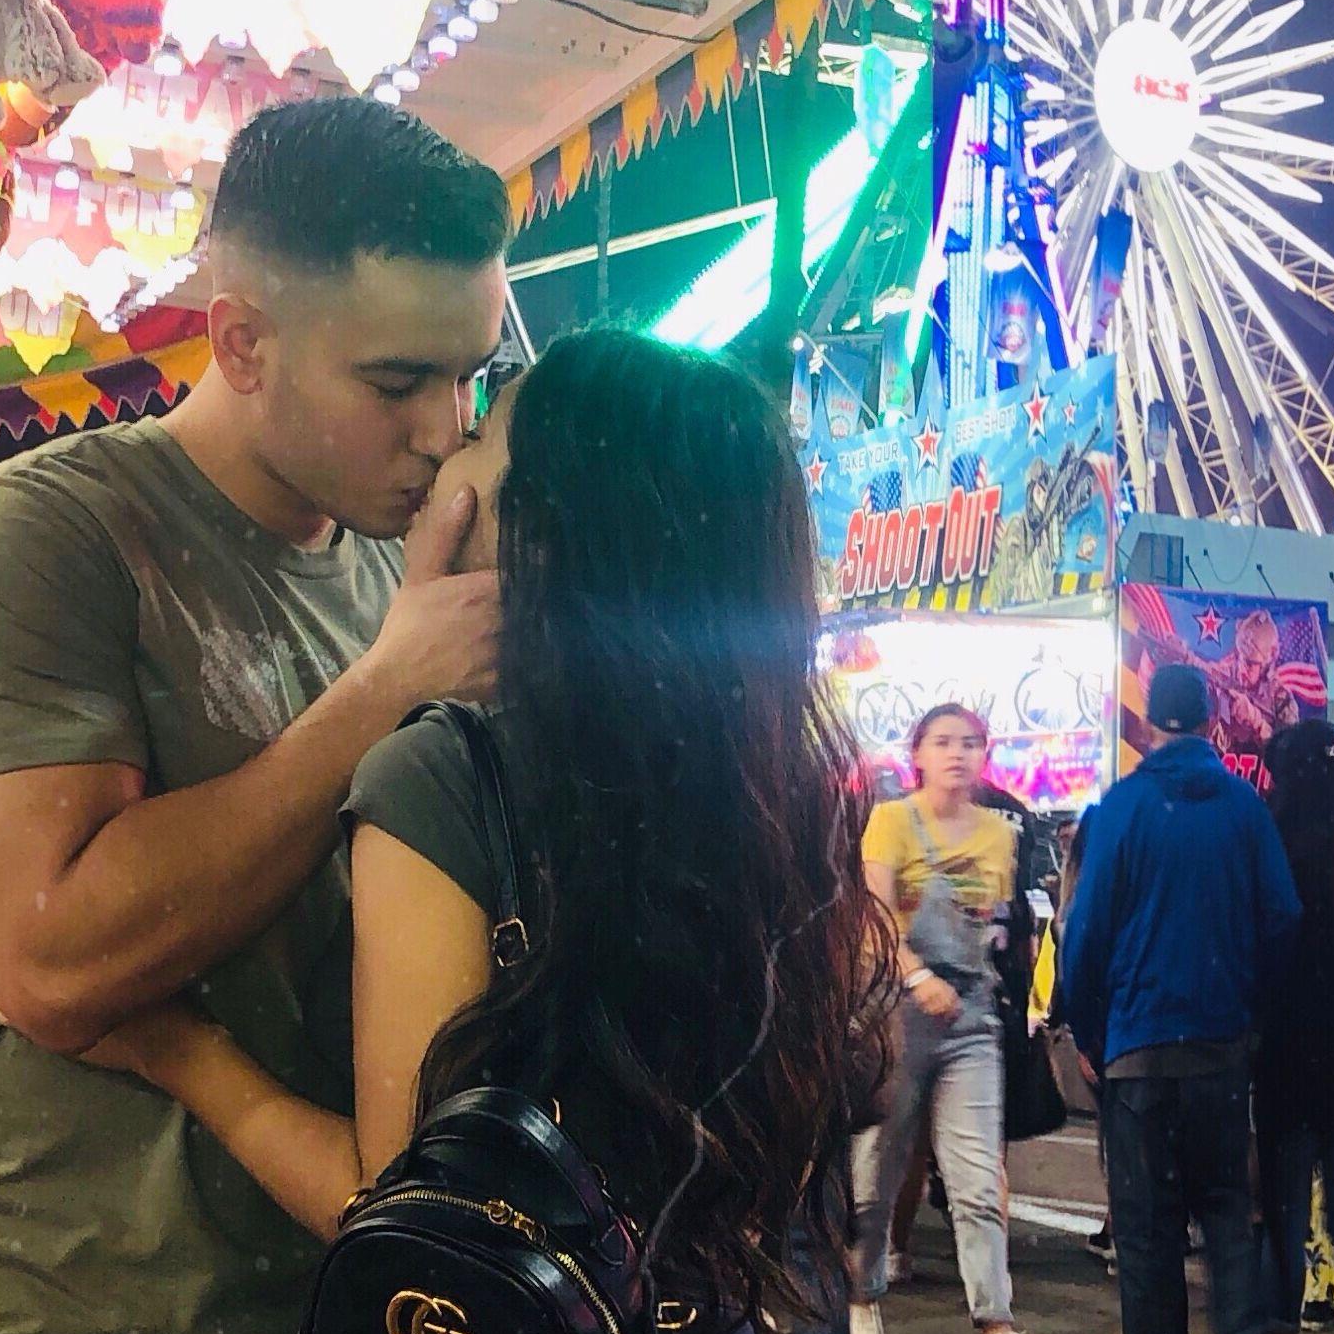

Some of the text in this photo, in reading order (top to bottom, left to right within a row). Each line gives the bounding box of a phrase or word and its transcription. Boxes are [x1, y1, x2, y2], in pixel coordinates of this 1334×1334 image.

[837, 450, 866, 471] TAKE
[867, 441, 900, 466] YOUR
[955, 417, 981, 443] BEST
